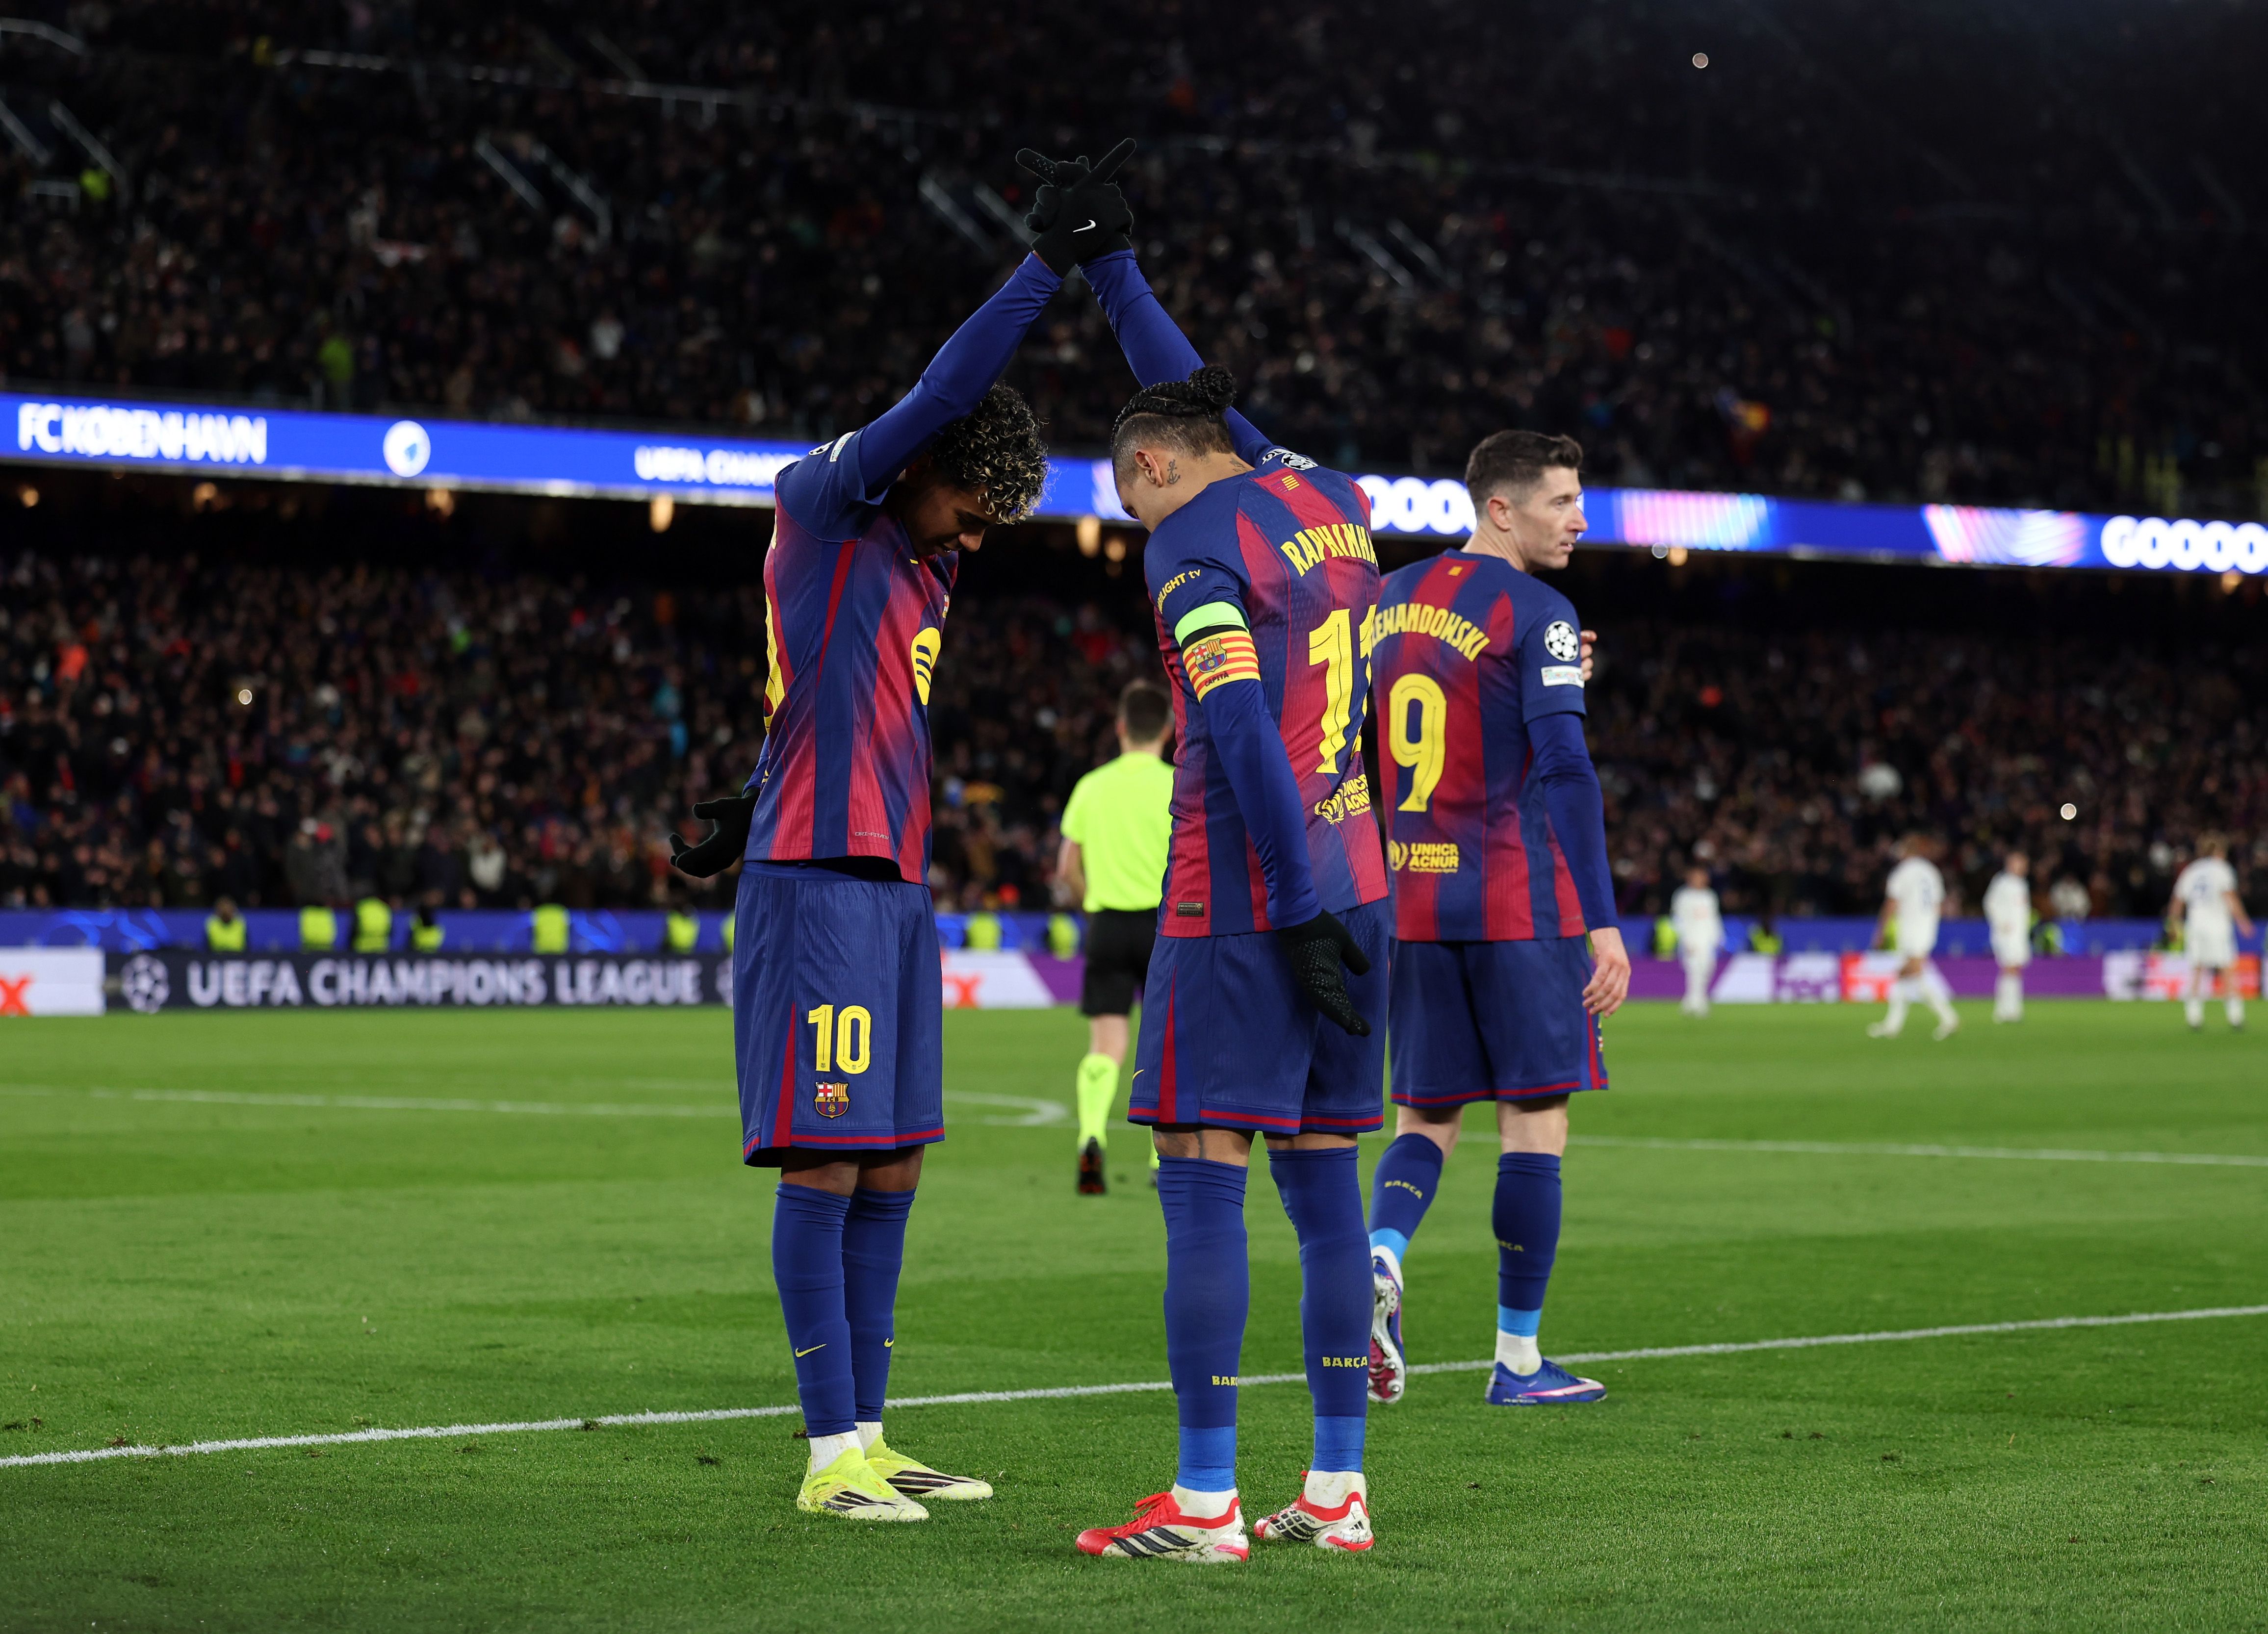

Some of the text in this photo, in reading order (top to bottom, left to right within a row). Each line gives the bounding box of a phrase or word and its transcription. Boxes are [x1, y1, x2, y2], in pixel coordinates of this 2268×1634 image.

[2101, 515, 2268, 574] GOOOO
[1188, 569, 1201, 579] tv
[1389, 673, 1447, 813] 9
[1408, 855, 1459, 868] ACNUR
[1410, 842, 1459, 856] UNHCR
[186, 959, 703, 1007] UEFA CHAMPIONS LEAGUE
[808, 1004, 871, 1074] 10
[1322, 1356, 1368, 1368] BARÇA
